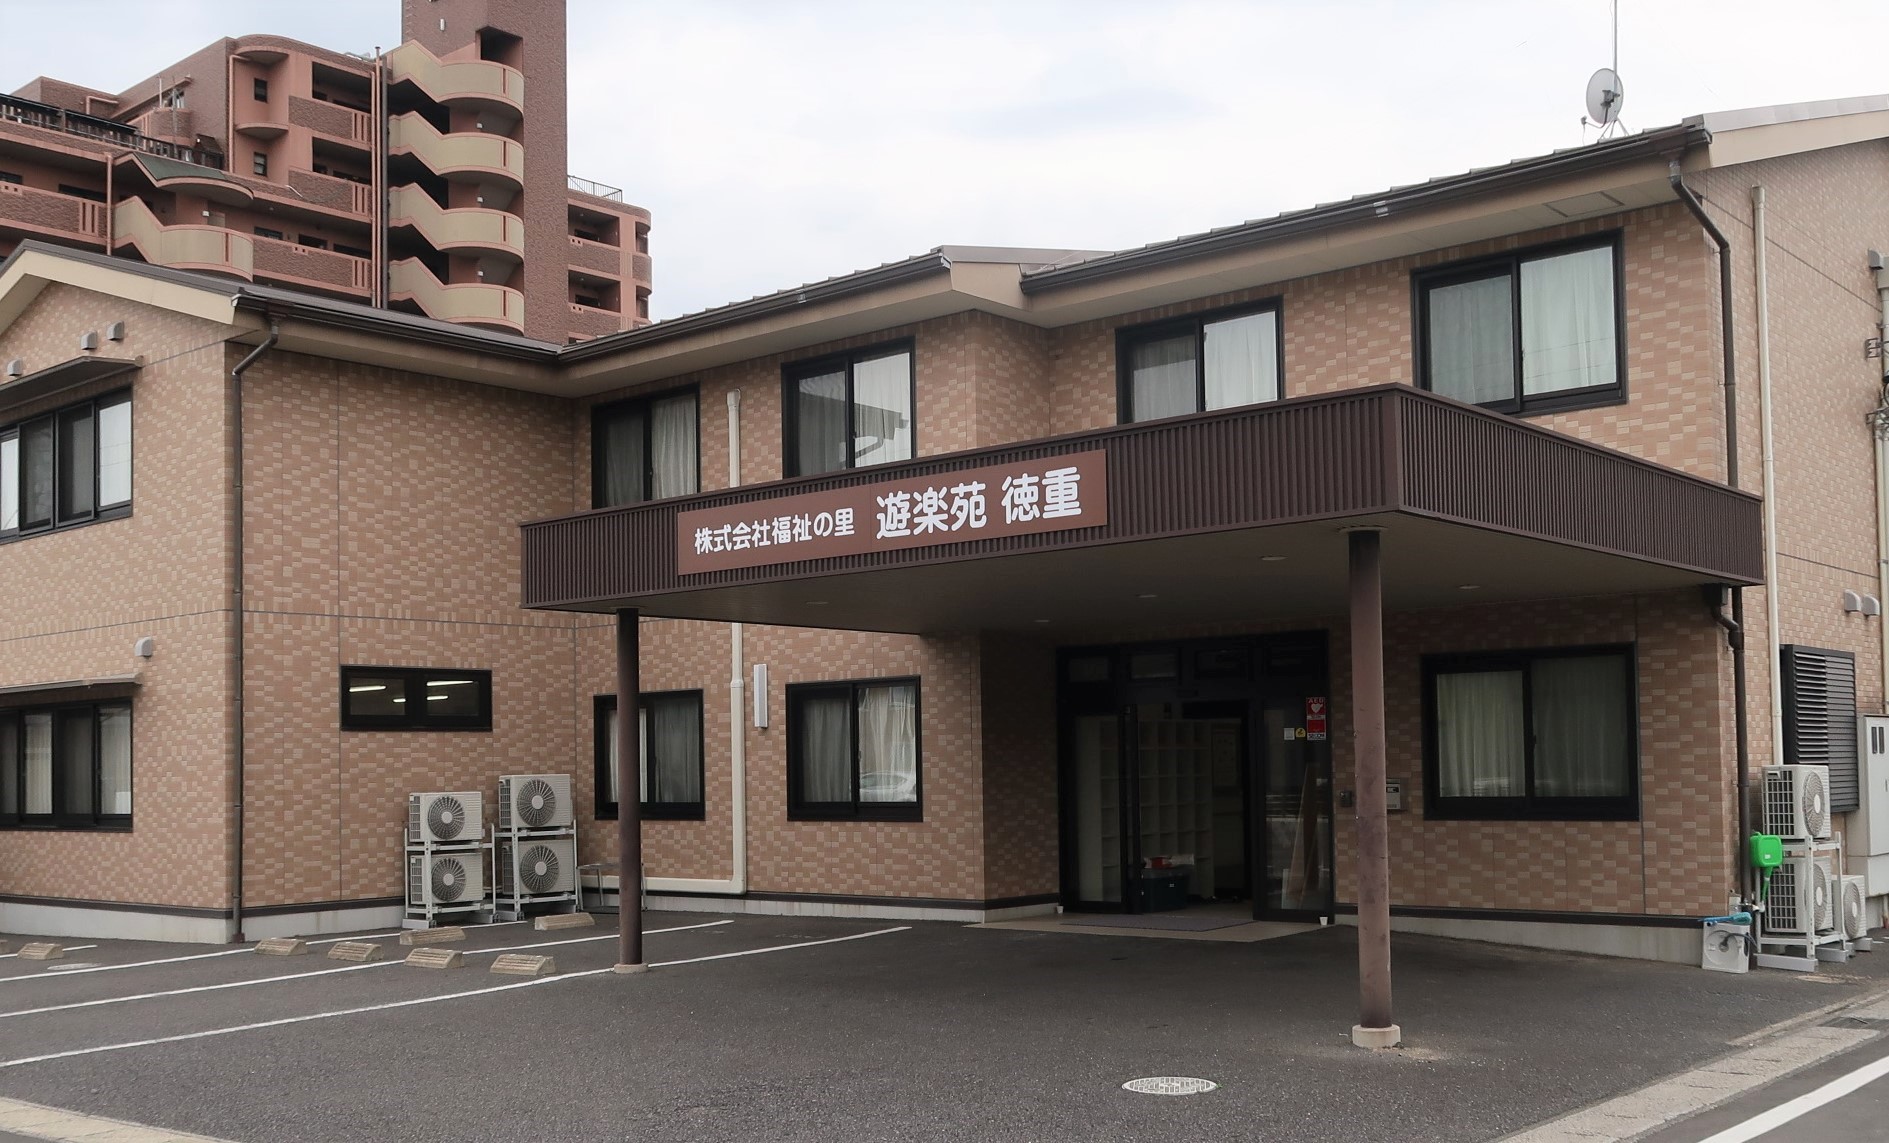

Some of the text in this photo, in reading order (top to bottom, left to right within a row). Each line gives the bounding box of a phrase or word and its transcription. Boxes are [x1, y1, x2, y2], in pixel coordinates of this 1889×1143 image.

[694, 467, 1082, 552] 株式会社福祉の里 遊楽苑 徳重
